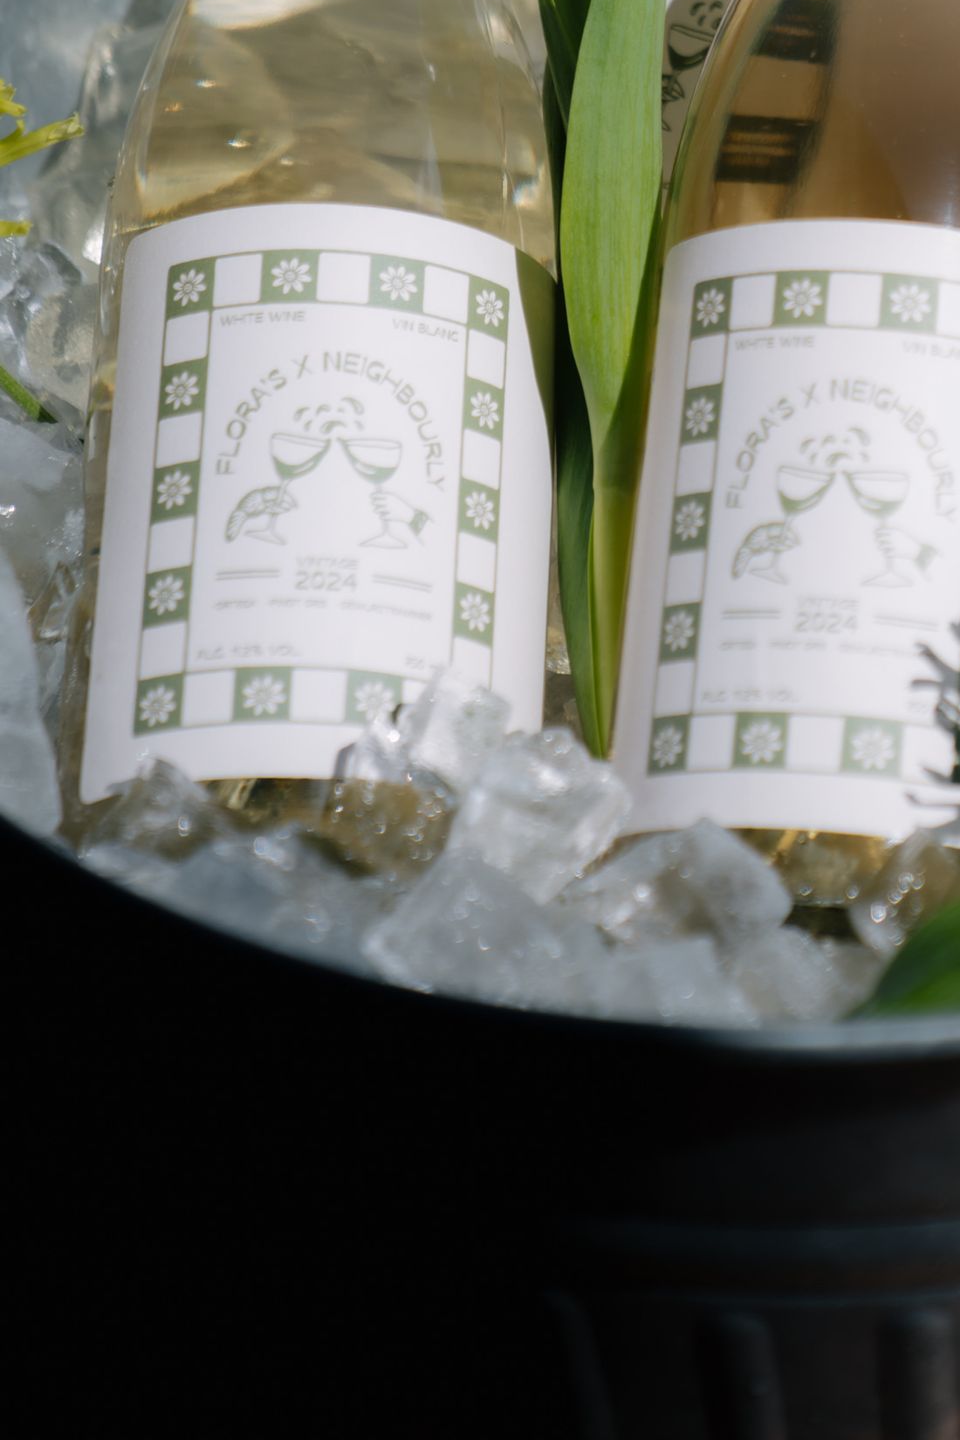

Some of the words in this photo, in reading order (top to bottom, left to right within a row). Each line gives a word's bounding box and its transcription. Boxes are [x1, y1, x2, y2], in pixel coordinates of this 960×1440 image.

[219, 311, 264, 327] WHITE
[268, 310, 306, 323] WINE
[392, 318, 415, 332] VIN
[418, 322, 459, 343] BLANC
[735, 336, 775, 351] WHITE
[779, 335, 815, 348] WINE
[214, 367, 288, 475] FLORA'S
[291, 354, 313, 380] X
[322, 351, 446, 492] NEIGHBOURLY
[725, 396, 796, 509] FLORA'S
[800, 382, 820, 408] X
[829, 378, 958, 523] NEIGHBOURLY
[294, 570, 358, 591] 2024
[794, 611, 858, 633] 2024
